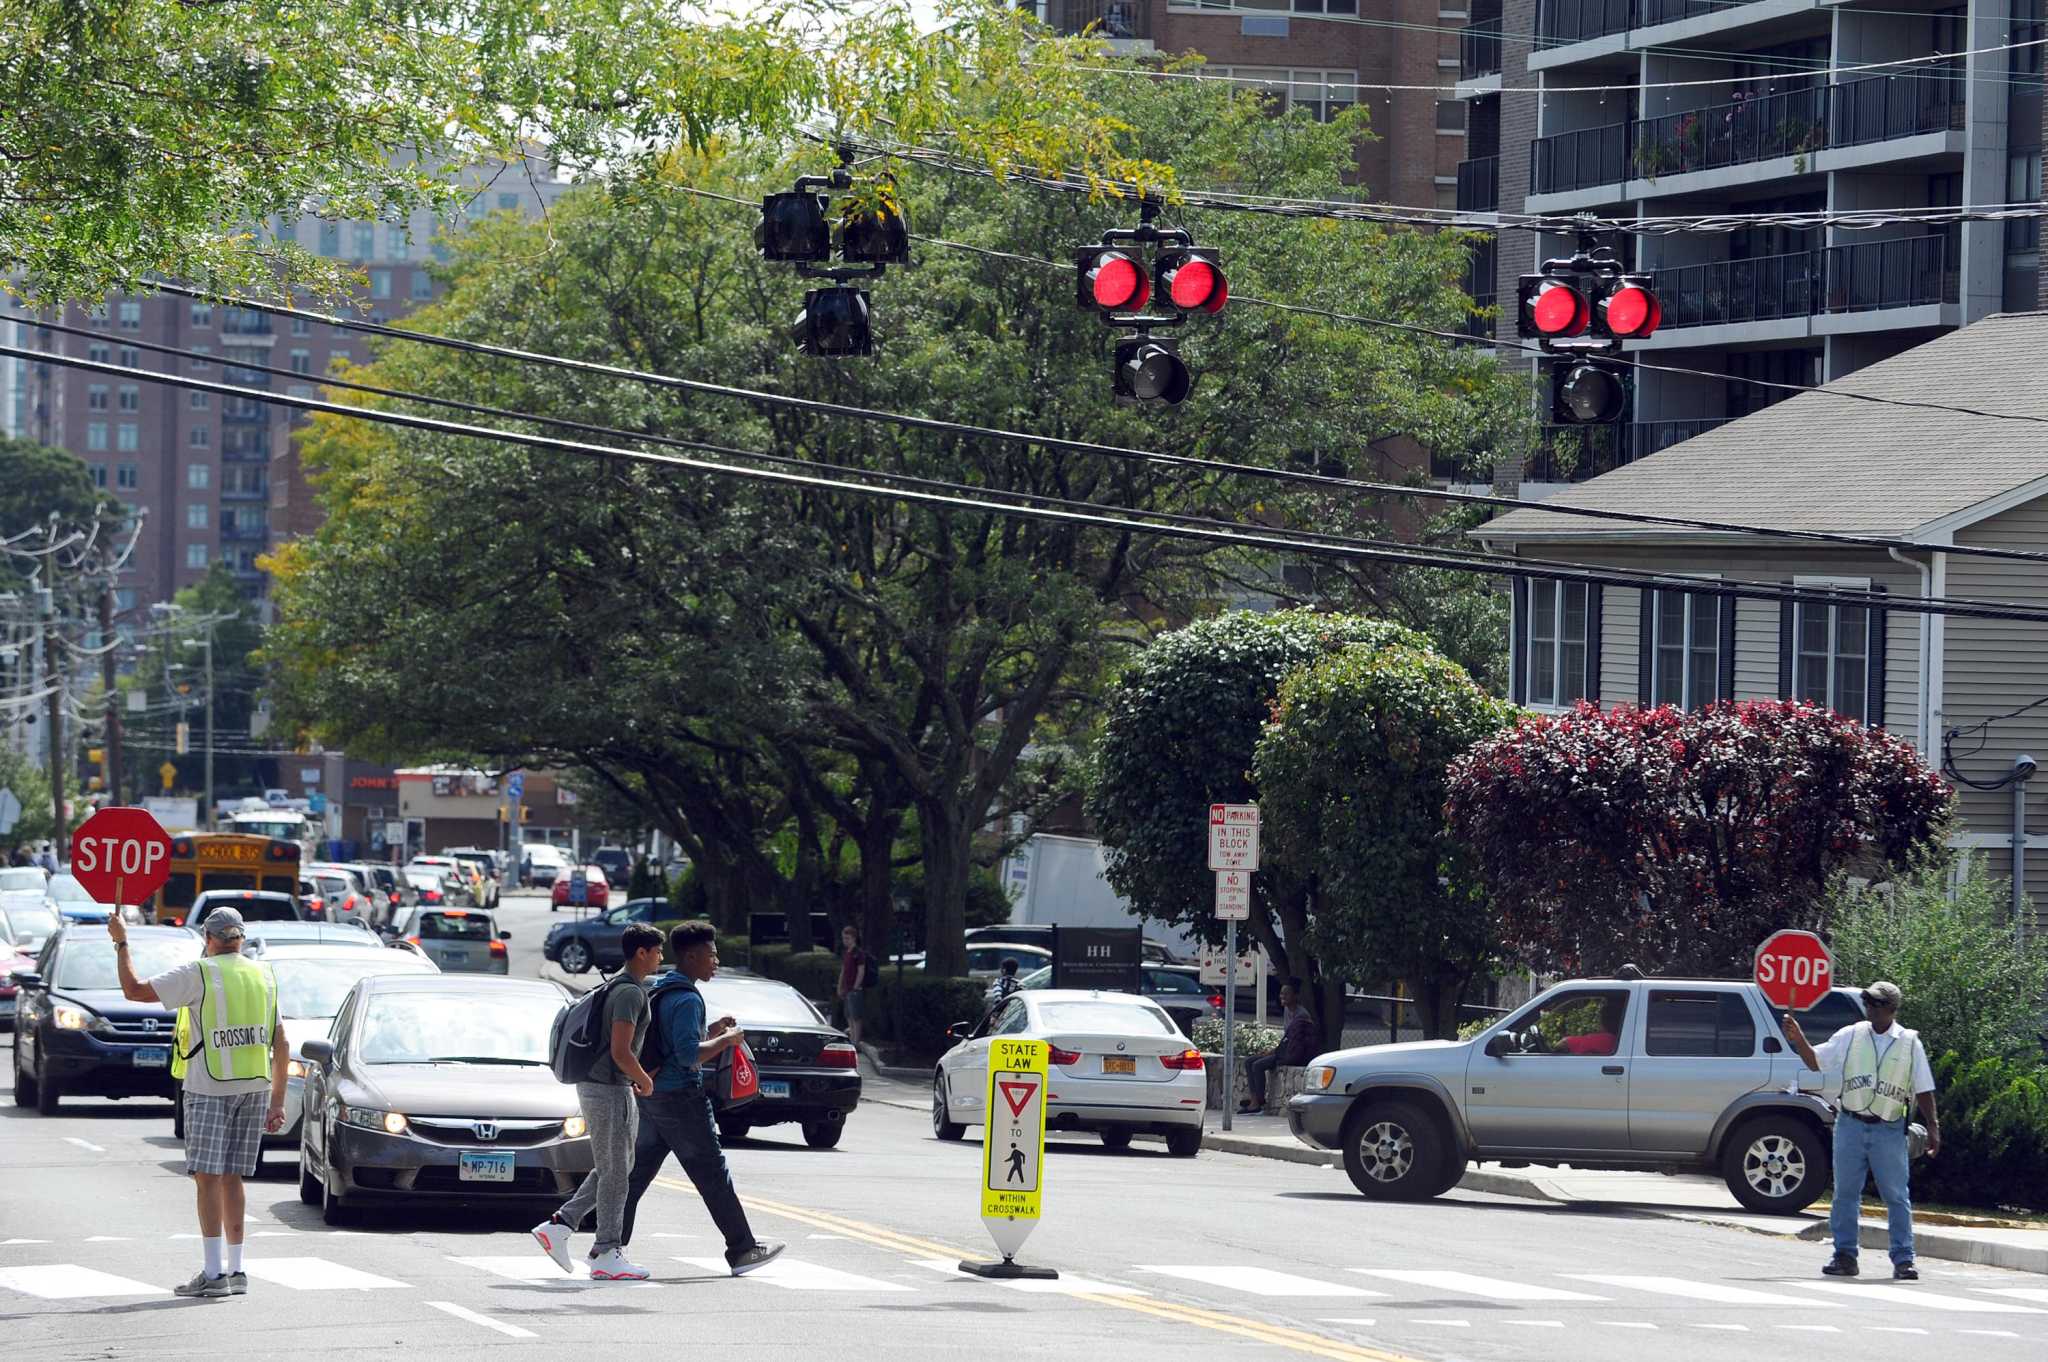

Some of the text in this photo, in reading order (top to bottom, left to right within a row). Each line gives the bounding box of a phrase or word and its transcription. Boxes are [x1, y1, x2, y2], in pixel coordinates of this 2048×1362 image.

[1212, 808, 1256, 821] NO PARKING
[1217, 827, 1250, 837] IN THIS
[1219, 838, 1248, 848] BLOCK
[77, 836, 165, 875] STOP
[1226, 876, 1239, 885] NO
[1219, 903, 1246, 911] STANDING
[1758, 953, 1829, 987] STOP
[213, 1026, 256, 1049] CROSSING
[1001, 1043, 1038, 1056] STATE
[1006, 1058, 1031, 1069] LAW
[1010, 1128, 1023, 1138] TO
[999, 1193, 1026, 1203] WITHIN
[987, 1204, 1036, 1215] CROSSWALK
